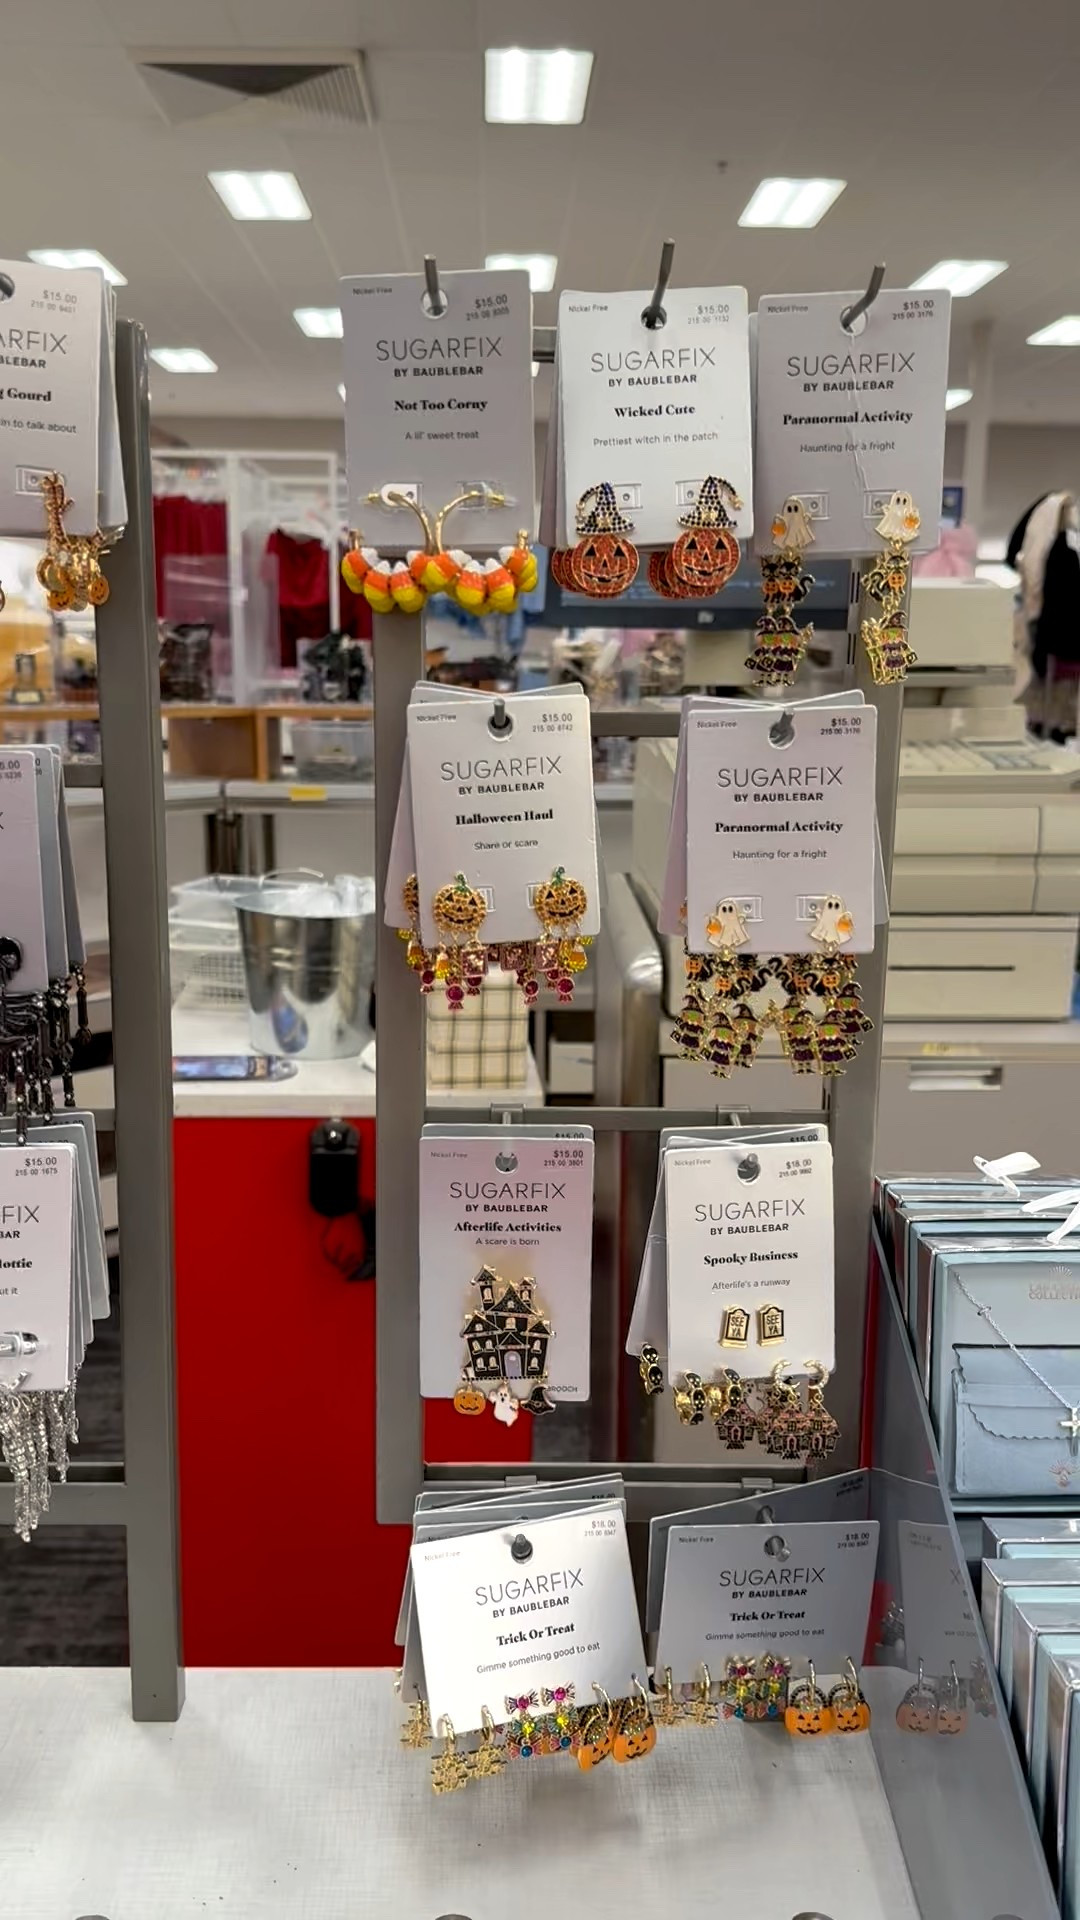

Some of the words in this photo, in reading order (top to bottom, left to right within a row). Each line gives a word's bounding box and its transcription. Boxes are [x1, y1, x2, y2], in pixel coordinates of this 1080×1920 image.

[43, 289, 78, 304] $15.00
[475, 294, 508, 309] $15.00
[697, 304, 730, 315] $15.00
[903, 300, 934, 311] $15.00
[892, 312, 905, 321] 215
[376, 337, 502, 361] SUGARFIX
[591, 347, 716, 373] SUGARFIX
[786, 352, 915, 377] SUGARFIX
[394, 368, 409, 378] BY
[413, 366, 484, 378] BAUBLEBAR
[608, 378, 623, 388] BY
[628, 374, 698, 386] BAUBLEBAR
[803, 383, 819, 393] BY
[823, 380, 894, 392] BAUBLEBAR
[7, 387, 52, 402] Gourd
[394, 400, 418, 411] Not
[419, 399, 445, 411] Too
[447, 398, 488, 412] Corny
[614, 405, 663, 418] Wicked
[665, 404, 696, 416] Cute
[783, 412, 859, 426] Paranormal
[861, 410, 913, 424] Activity
[13, 419, 24, 428] to
[26, 420, 45, 430] talk
[47, 423, 77, 434] about
[405, 431, 413, 440] A
[427, 432, 454, 441] sweet
[456, 430, 479, 440] treat
[593, 437, 632, 447] Prettiest
[635, 435, 660, 445] witch
[663, 434, 671, 443] in
[674, 433, 689, 443] the
[692, 431, 719, 443] patch
[800, 443, 843, 454] Haunting
[845, 442, 859, 452] for
[861, 443, 867, 451] a
[869, 441, 895, 453] fright
[542, 713, 573, 724] $15.00
[831, 717, 862, 728] $15.00
[532, 725, 545, 733] 215
[546, 724, 556, 732] 00
[820, 728, 832, 736] 215
[440, 756, 562, 781] SUGARFIX
[717, 766, 844, 788] SUGARFIX
[458, 786, 473, 795] BY
[477, 782, 545, 794] BAUBLEBAR
[734, 793, 748, 803] BY
[753, 792, 824, 803] BAUBLEBAR
[456, 812, 522, 826] Halloween
[523, 809, 554, 822] Haul
[715, 821, 790, 833] Paranormal
[792, 821, 843, 834] Activity
[474, 841, 500, 851] Share
[502, 841, 512, 849] or
[514, 839, 539, 848] scare
[732, 850, 775, 860] Haunting
[777, 850, 790, 859] for
[801, 850, 827, 860] fright
[553, 1150, 584, 1159] $15.00
[25, 1157, 57, 1167] $15.00
[543, 1159, 556, 1167] 215
[557, 1159, 567, 1167] 00
[15, 1169, 27, 1177] 215
[30, 1168, 39, 1176] 00
[450, 1181, 567, 1200] SUGARFIX
[465, 1204, 479, 1213] BY
[483, 1204, 548, 1213] BAUBLEBAR
[695, 1198, 806, 1222] SUGARFIX
[454, 1221, 504, 1232] Afterlife
[505, 1221, 562, 1233] Activities
[710, 1227, 724, 1236] BY
[727, 1223, 790, 1235] BAUBLEBAR
[519, 1237, 540, 1246] born
[0, 1258, 33, 1269] ottie
[703, 1253, 748, 1267] Spooky
[749, 1250, 799, 1263] Business
[11, 1287, 18, 1295] it
[712, 1279, 751, 1290] Afterlife's
[760, 1279, 791, 1288] runway
[731, 1316, 745, 1327] SEE
[766, 1314, 780, 1325] SEE
[732, 1328, 741, 1337] YA
[768, 1325, 779, 1335] YA
[719, 1567, 826, 1587] SUGARFIX
[475, 1568, 584, 1606] SUGARFIX
[732, 1591, 744, 1599] BY
[749, 1589, 807, 1599] BAUBLEBAR
[492, 1608, 506, 1619] BY
[509, 1596, 570, 1616] BAUBLEBAR
[729, 1612, 759, 1622] Trick
[761, 1611, 775, 1621] Or
[777, 1610, 806, 1621] Treat
[496, 1632, 528, 1646] Trick
[529, 1628, 544, 1639] Or
[545, 1622, 576, 1638] Treat
[705, 1632, 734, 1641] Gimme
[735, 1631, 777, 1641] something
[779, 1629, 800, 1639] good
[802, 1628, 810, 1636] to
[812, 1628, 825, 1636] eat
[477, 1662, 507, 1674] Gimme
[508, 1652, 551, 1668] something
[553, 1646, 575, 1659] good
[576, 1646, 586, 1654] to
[587, 1642, 601, 1652] eat
